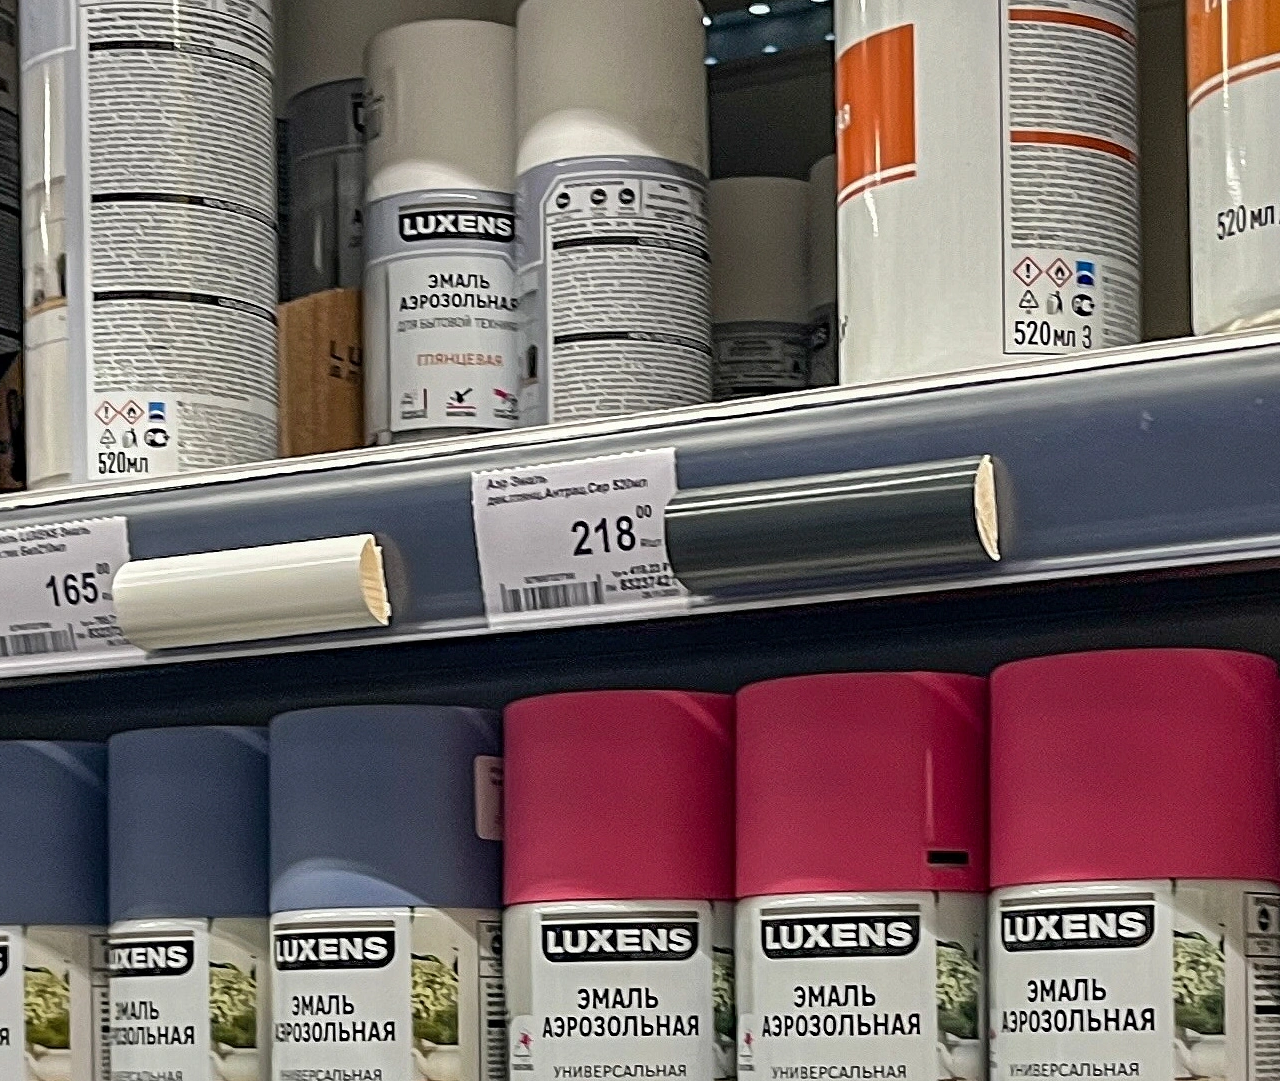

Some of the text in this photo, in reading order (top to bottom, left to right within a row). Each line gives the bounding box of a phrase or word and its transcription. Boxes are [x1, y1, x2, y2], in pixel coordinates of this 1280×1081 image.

[403, 215, 514, 238] LUXENS
[427, 274, 491, 290] ЭМАЛЬ
[98, 451, 149, 475] 520мл
[571, 515, 637, 557] 218
[46, 571, 99, 607] 165
[765, 921, 914, 950] LUXENS
[1003, 911, 1147, 942] LUXENS
[276, 936, 388, 963] LUXENS
[546, 928, 692, 954] LUXENS
[577, 987, 659, 1010] ЭМАЛЬ
[793, 985, 877, 1008] ЭМАЛЬ
[1027, 978, 1108, 1002] ЭМАЛЬ
[292, 995, 355, 1016] ЭМАЛЬ
[542, 1015, 700, 1038] АЭРОЗОЛЬНАЯ
[762, 1013, 922, 1037] АЭРОЗОЛЬНАЯ
[1001, 1007, 1157, 1033] АЭРОЗОЛЬНАЯ
[553, 1064, 688, 1079] УНИВЕРСАЛЬНАЯ
[772, 1064, 907, 1080] УНИВЕРСАЛЬНАЯ
